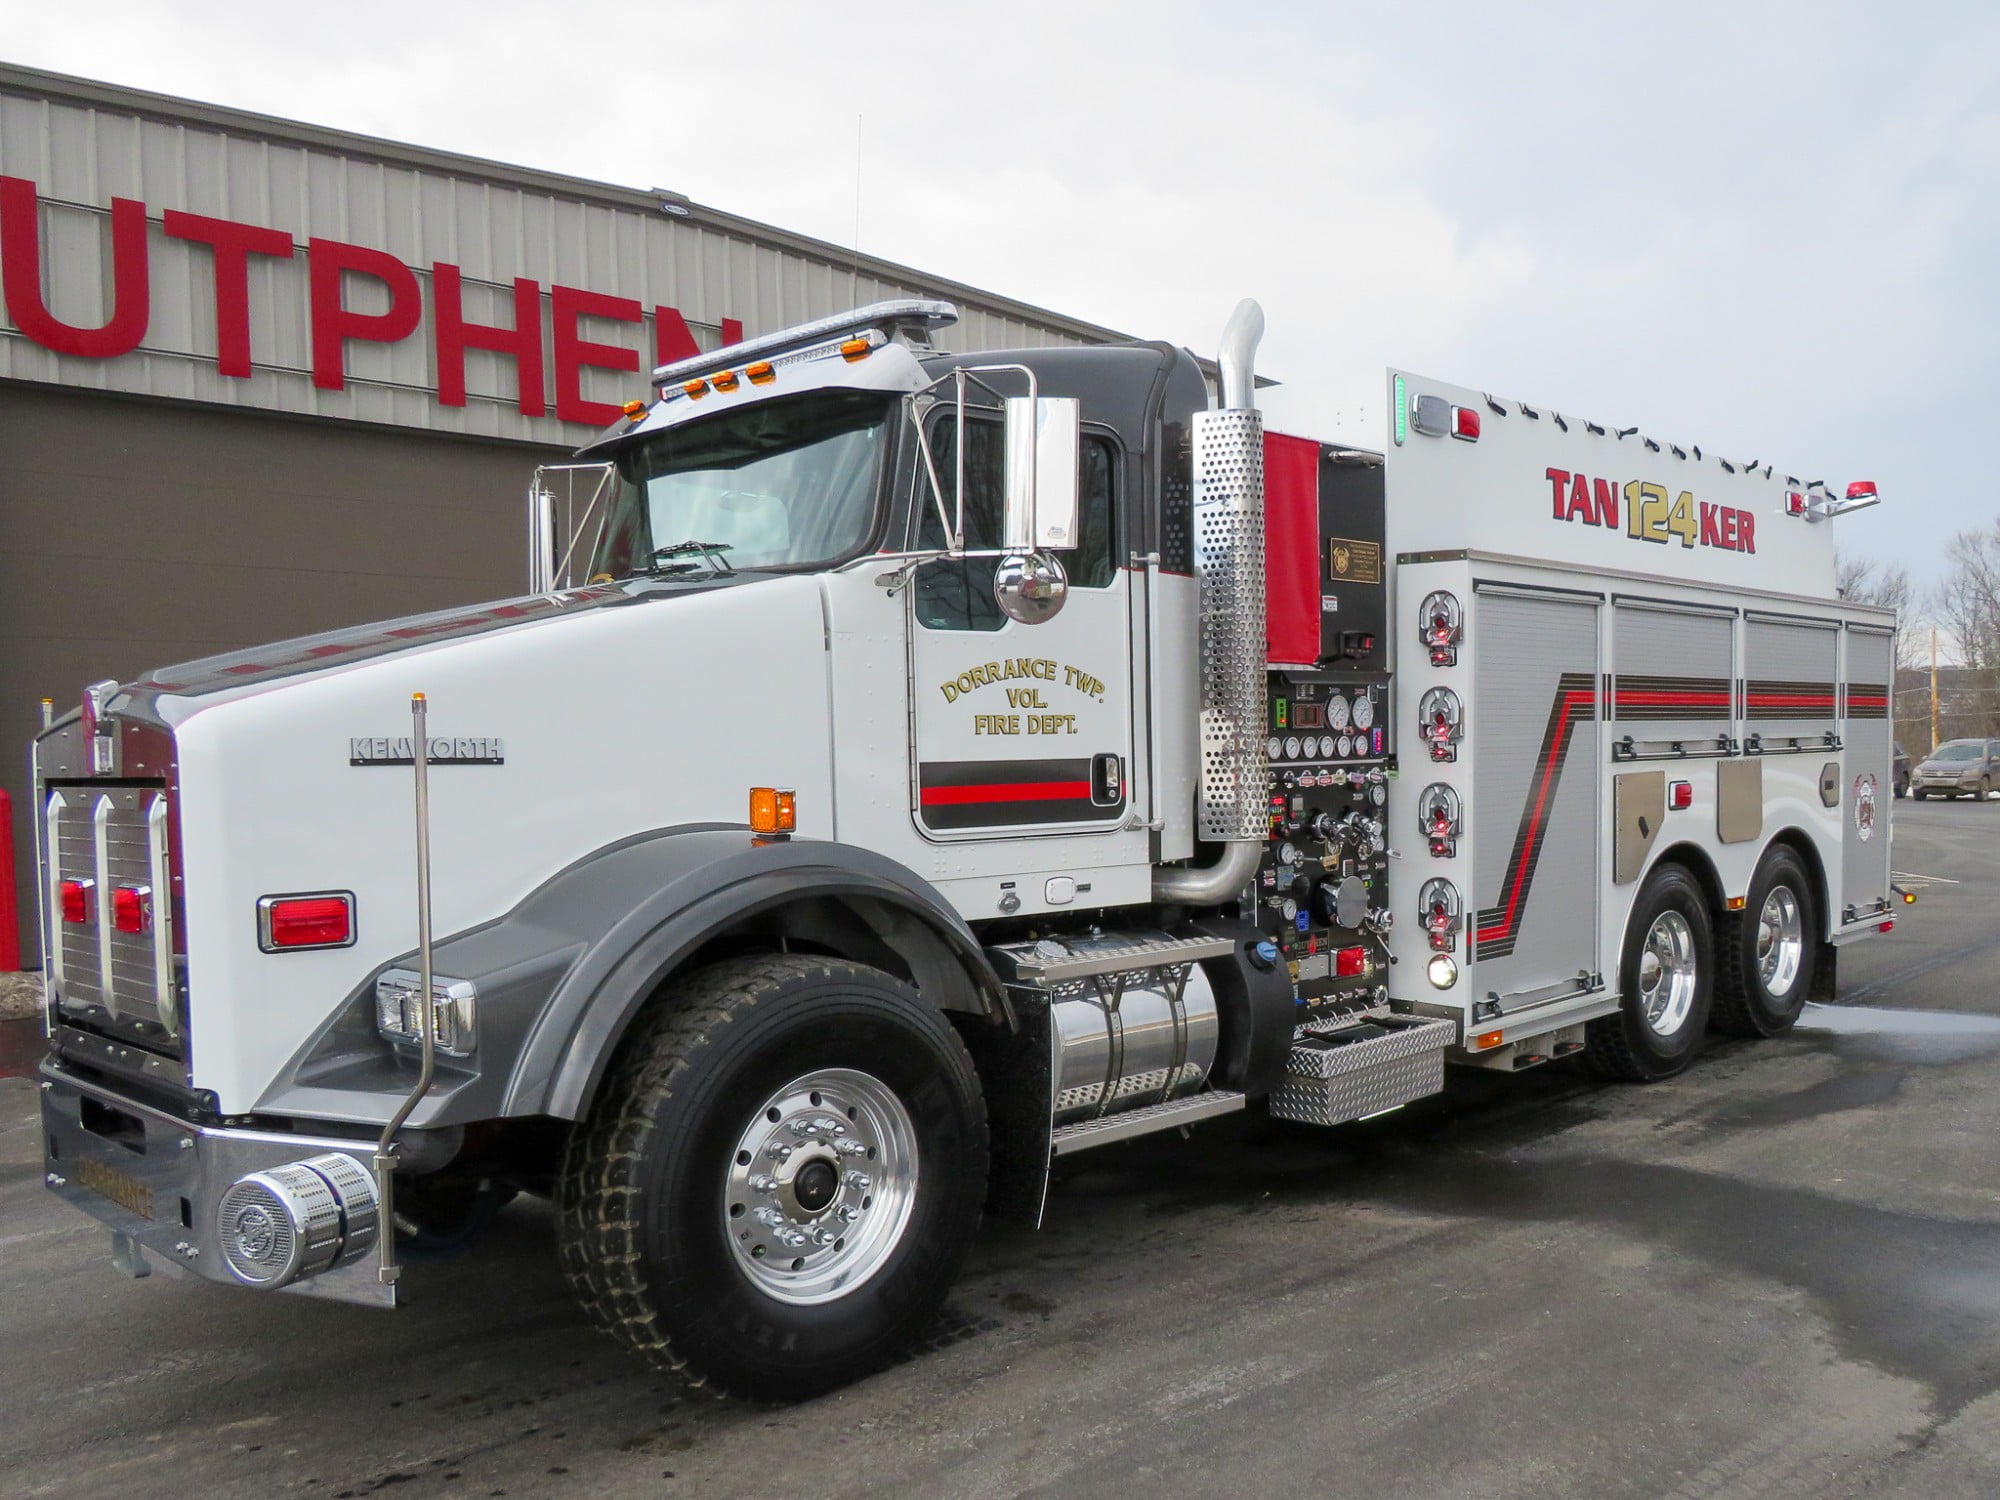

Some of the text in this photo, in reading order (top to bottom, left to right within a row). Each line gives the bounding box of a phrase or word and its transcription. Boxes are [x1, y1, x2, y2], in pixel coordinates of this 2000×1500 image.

[1546, 467, 1757, 554] TAN 124 KER
[940, 657, 1106, 704] DORRANCE TWP.
[1006, 688, 1049, 708] VOL.
[974, 714, 1078, 735] FIRE DEPT.
[350, 737, 504, 759] KENWORTH
